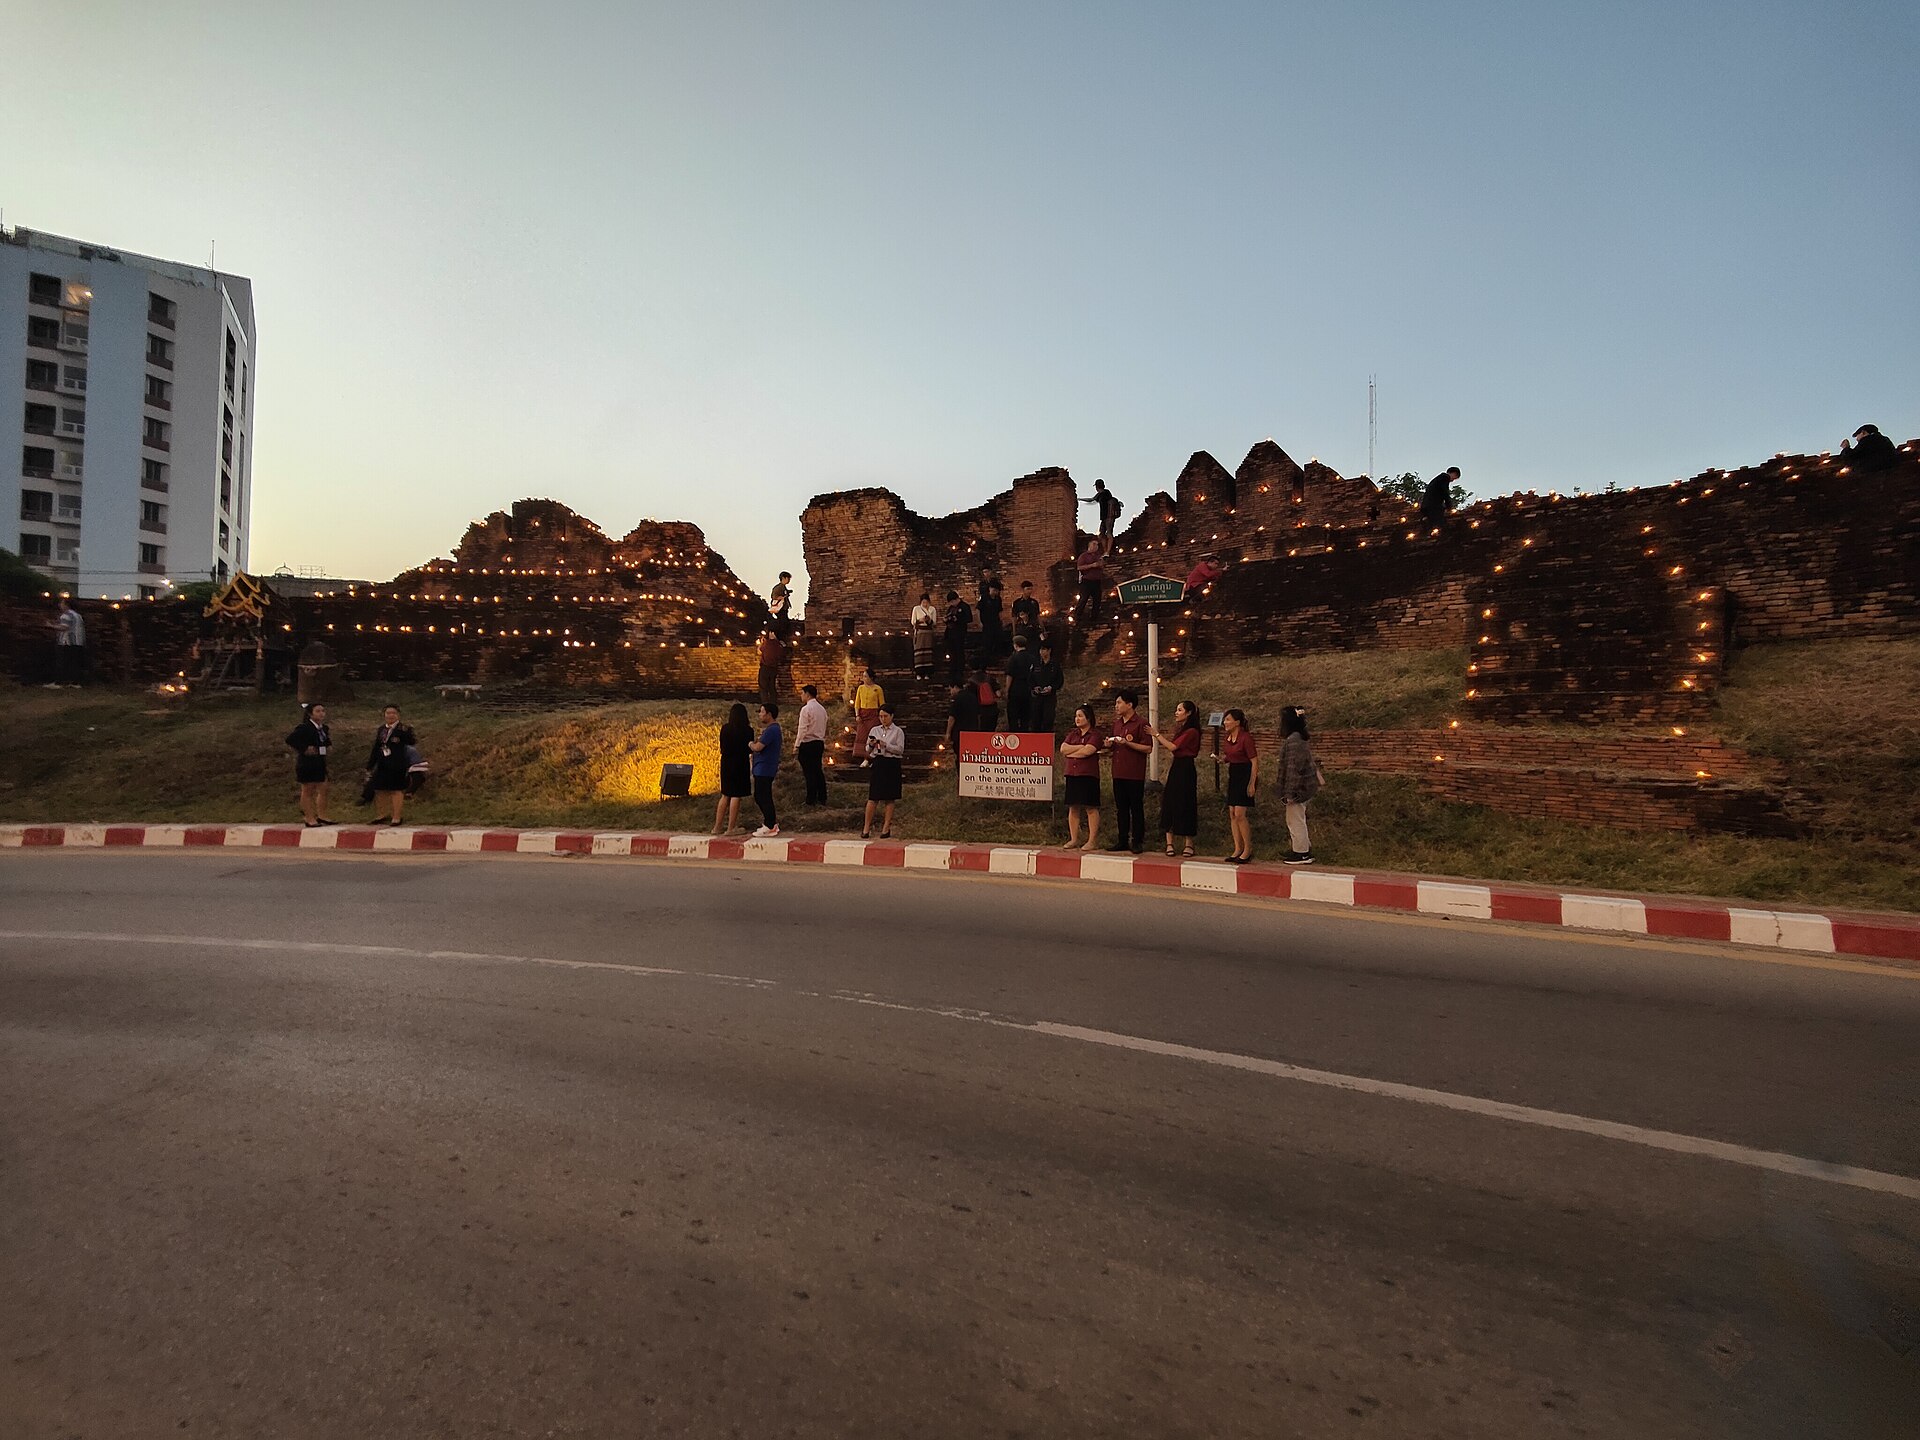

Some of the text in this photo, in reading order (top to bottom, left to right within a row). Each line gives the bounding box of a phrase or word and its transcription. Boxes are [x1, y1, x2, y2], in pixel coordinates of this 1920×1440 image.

[962, 748, 1051, 764] ห้ามขึ้นกำแพงเมือง
[979, 765, 991, 773] Do
[1012, 767, 1031, 775] walk
[979, 774, 992, 783] the
[995, 776, 1025, 784] ancient
[1028, 777, 1046, 785] wall
